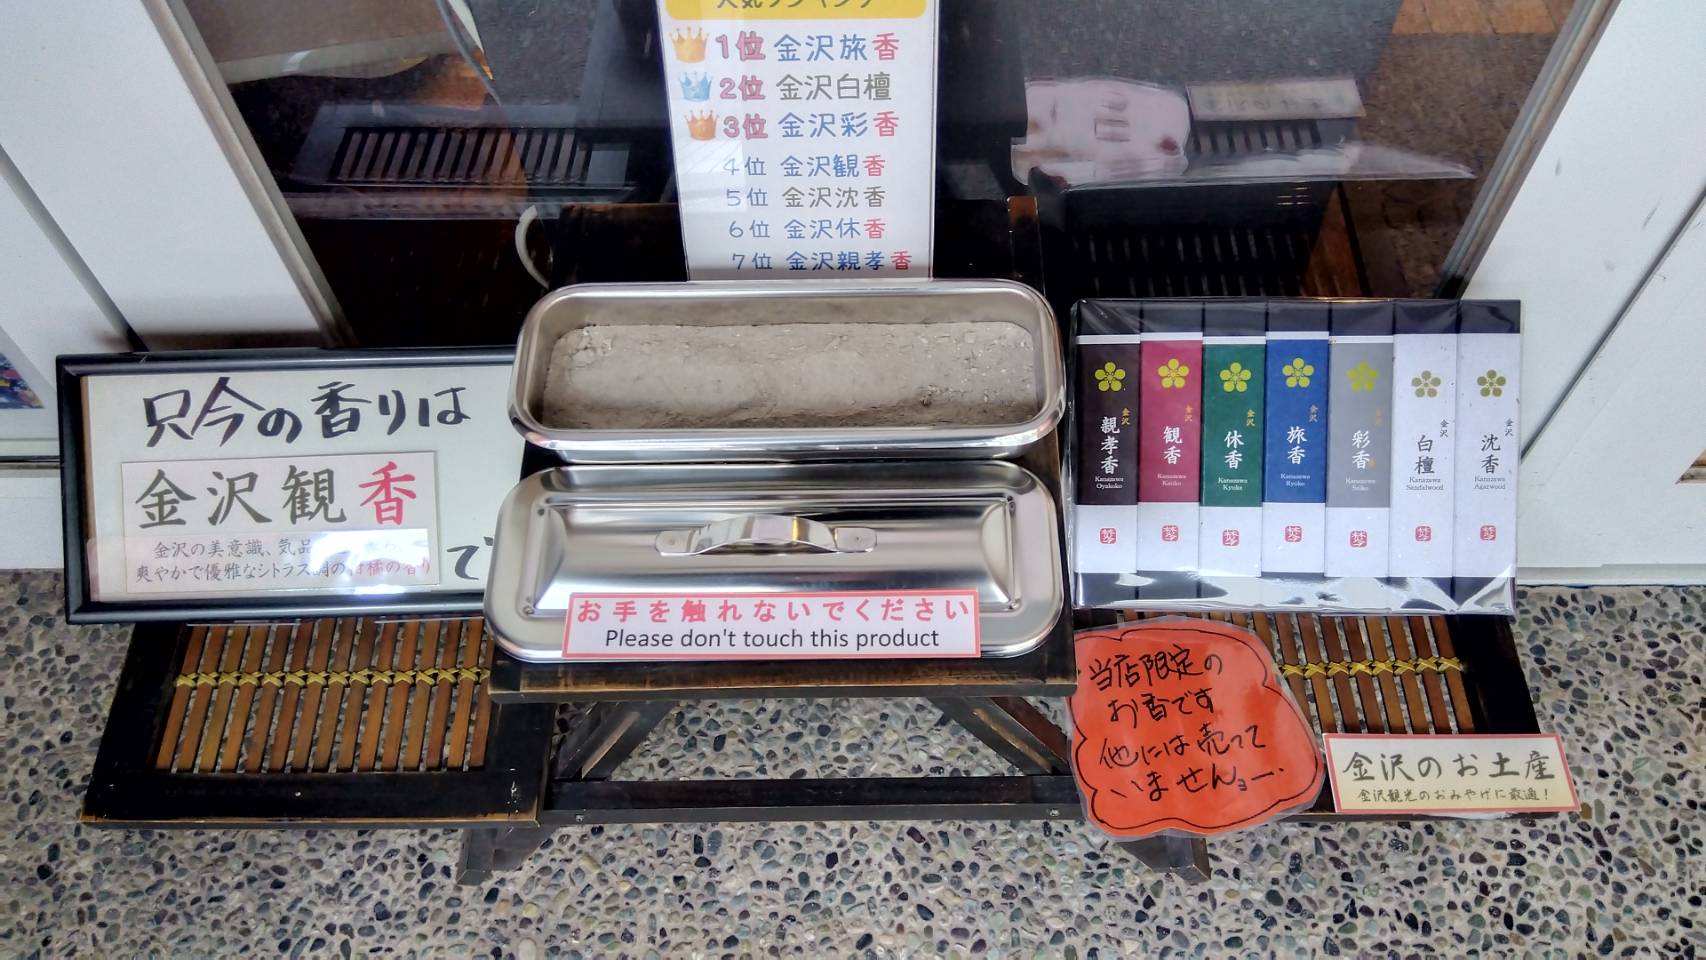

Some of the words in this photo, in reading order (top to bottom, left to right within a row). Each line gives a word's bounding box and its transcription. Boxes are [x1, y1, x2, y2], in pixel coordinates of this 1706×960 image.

[715, 31, 766, 61] 1位
[773, 32, 900, 62] 金沢旅香
[719, 75, 766, 101] 2位
[775, 71, 892, 101] 金沢白檀
[723, 113, 768, 140] 3位
[778, 111, 900, 138] 金沢彩香
[722, 155, 767, 178] 4位
[780, 154, 886, 178] 金沢観香
[726, 187, 769, 208] 5位
[781, 186, 886, 208] 金沢沈香
[729, 219, 771, 239] 6位
[783, 218, 886, 239] 金沢休香
[732, 252, 773, 271] 7位
[785, 250, 912, 271] 金沢親孝香
[142, 376, 471, 448] 只今の香りは
[1439, 419, 1450, 438] 金沢
[1504, 418, 1514, 437] 金沢
[1100, 416, 1120, 475] 親孝香
[1163, 425, 1183, 465] 観香
[1224, 430, 1244, 469] 休香
[1286, 425, 1308, 465] 旅香
[1351, 429, 1371, 469] 彩香
[1414, 434, 1435, 475] 白檀
[1480, 434, 1501, 475] 沈香
[135, 461, 417, 528] 金沢観香
[577, 598, 969, 623] お手を触れないでください
[605, 629, 673, 648] Please
[680, 629, 736, 648] don't
[743, 628, 803, 648] touch
[810, 628, 850, 648] this
[856, 628, 940, 652] product
[1088, 643, 1223, 692] 当店限定の
[1107, 687, 1214, 729] お香です
[1099, 722, 1267, 769] 他には売って
[1342, 750, 1555, 782] 金沢のお土産
